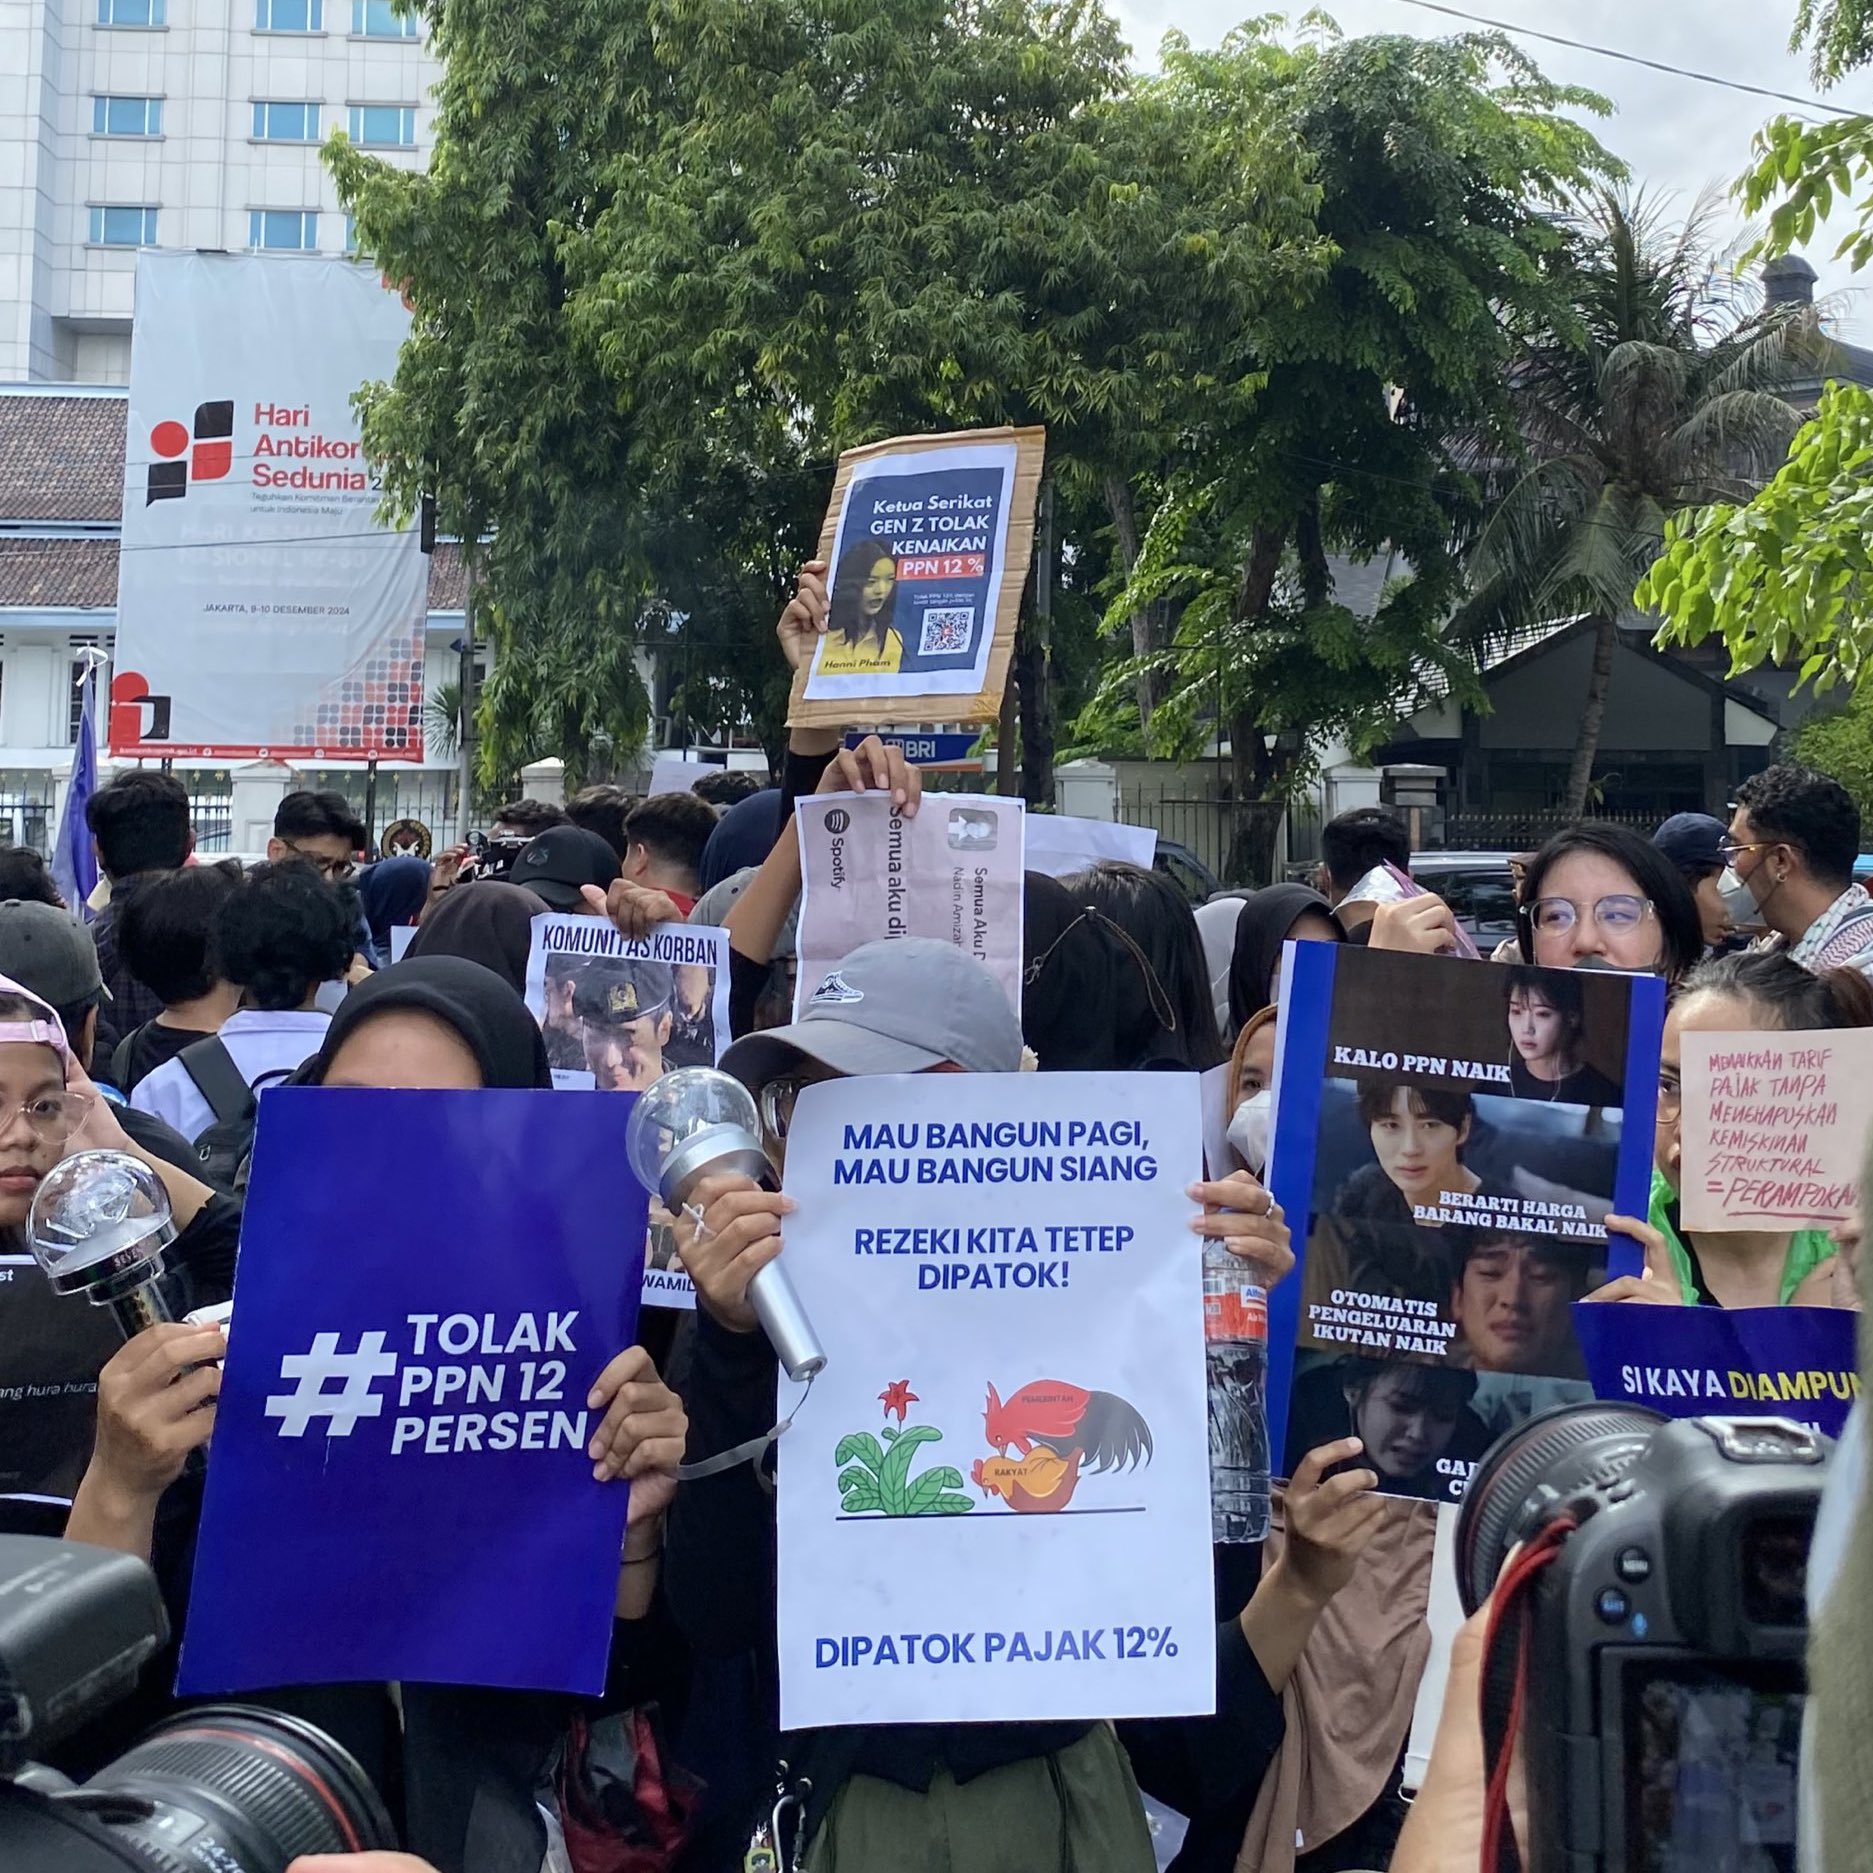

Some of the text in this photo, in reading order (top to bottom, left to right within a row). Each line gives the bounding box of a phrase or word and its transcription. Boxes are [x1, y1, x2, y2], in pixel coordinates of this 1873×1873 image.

[254, 403, 310, 427] Hari
[253, 434, 361, 459] Antikor
[252, 463, 366, 490] Sedunia
[277, 504, 320, 514] Indonesia
[873, 494, 993, 515] Ketua Serikat
[870, 515, 990, 535] GEN Z TOLAK
[892, 536, 987, 556] KENAIKAN
[902, 560, 985, 576] PPN 12 %
[203, 604, 249, 614] JAKARTA,
[272, 604, 326, 615] DESEMBER
[327, 605, 350, 616] 2024
[859, 657, 891, 668] Pham
[905, 740, 936, 758] BRI
[829, 837, 847, 891] Spotify
[887, 875, 907, 912] aku
[952, 866, 965, 902] Nadin
[973, 867, 988, 916] Semua
[542, 925, 718, 965] KOMUNITAS KORBAN
[973, 917, 988, 948] Aku
[1334, 1046, 1511, 1083] KALO PPN NAIK
[1709, 1048, 1833, 1072] MENAIKKAN TARIF
[1769, 1074, 1827, 1100] TANPA
[1709, 1101, 1837, 1130] MENGHAPUSKAN
[843, 1120, 1149, 1150] MAU BANGUN PAGI,
[1709, 1128, 1808, 1154] KEMISKINAN
[834, 1155, 1158, 1185] MAU BANGUN SIANG
[1705, 1152, 1826, 1178] STRUKTURAL
[1439, 1190, 1587, 1220] BERARTI HARGA
[1413, 1205, 1609, 1239] BARANG BAKAL NAIK
[854, 1225, 1134, 1255] REZEKI KITA TETEP
[918, 1260, 1070, 1290] DIPATOK!
[1331, 1289, 1438, 1317] OTOMATIS
[406, 1310, 580, 1355] TOLAK
[1308, 1304, 1457, 1338] PENGELUARAN
[1313, 1323, 1448, 1356] IKUTAN NAIK
[26, 1382, 61, 1395] hura
[63, 1381, 98, 1394] hura
[399, 1359, 567, 1407] PPN 12
[1622, 1364, 1643, 1395] SI
[1645, 1367, 1727, 1398] KAYA
[390, 1410, 588, 1455] PERSEN
[994, 1467, 1028, 1477] RAKYAT
[1436, 1457, 1480, 1480] GAJ
[815, 1626, 1178, 1668] DIPATOK PAJAK 12%
